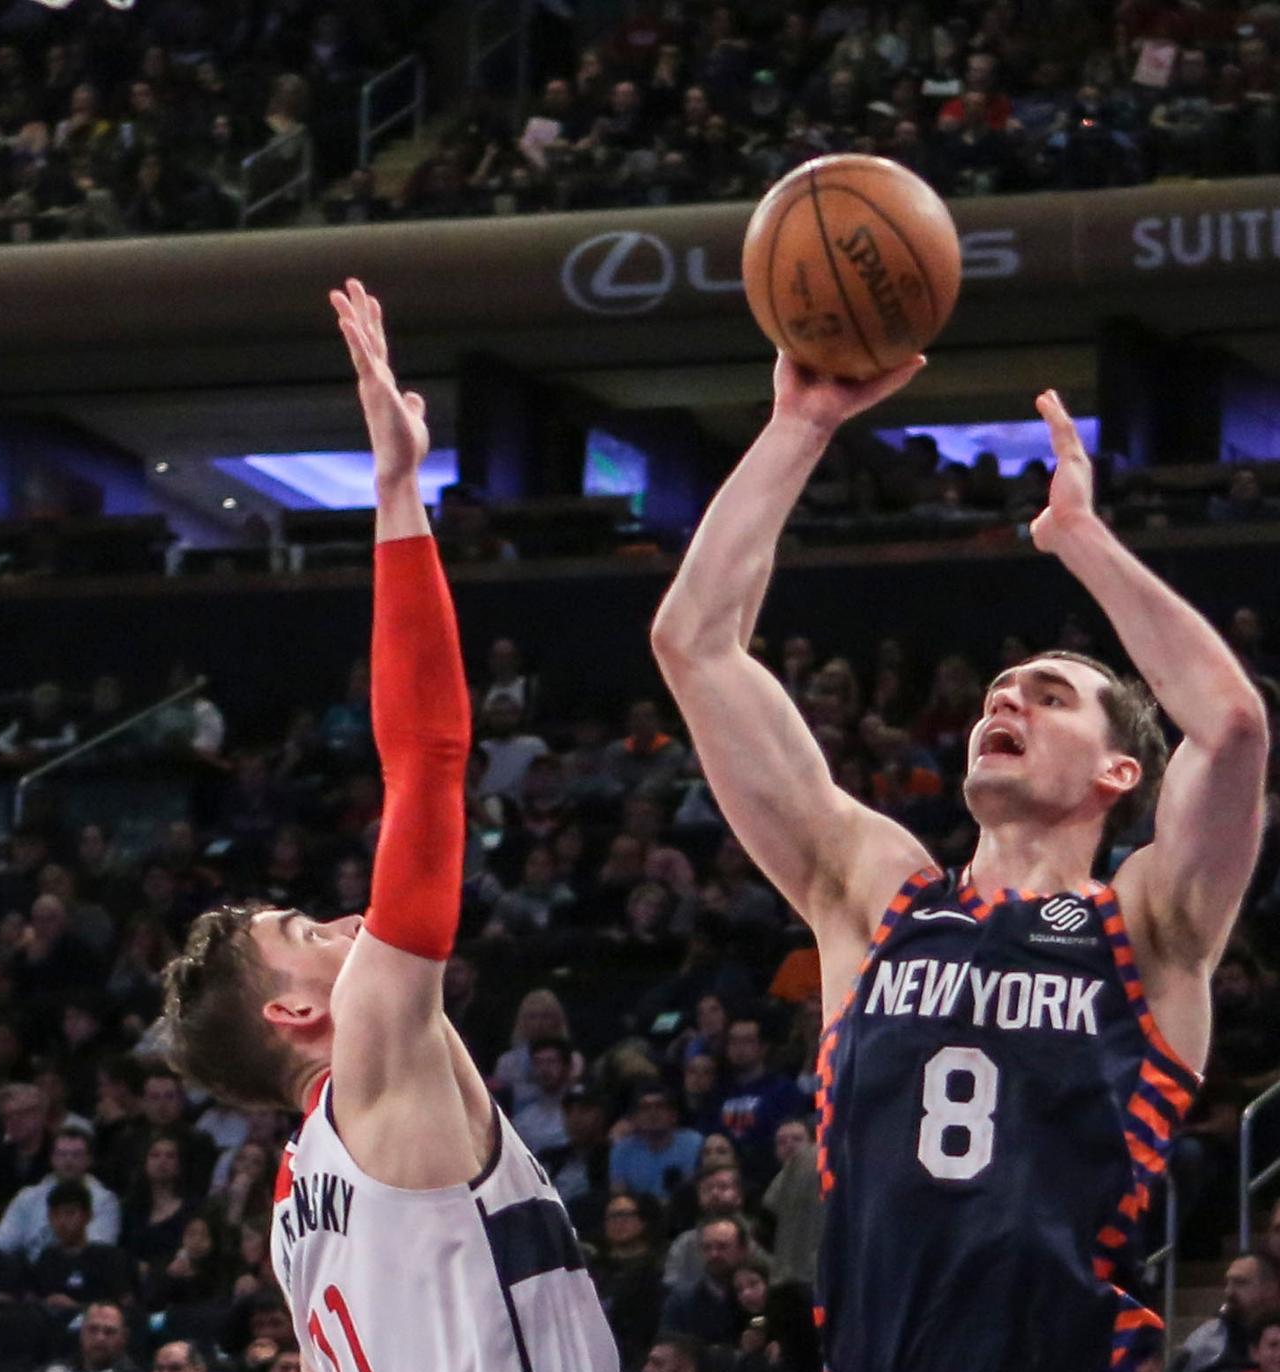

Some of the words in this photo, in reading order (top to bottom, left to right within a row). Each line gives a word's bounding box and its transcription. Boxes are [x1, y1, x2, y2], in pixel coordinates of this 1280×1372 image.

[864, 959, 970, 1017] NEW
[970, 967, 1105, 1035] YORK
[917, 1046, 999, 1180] 8
